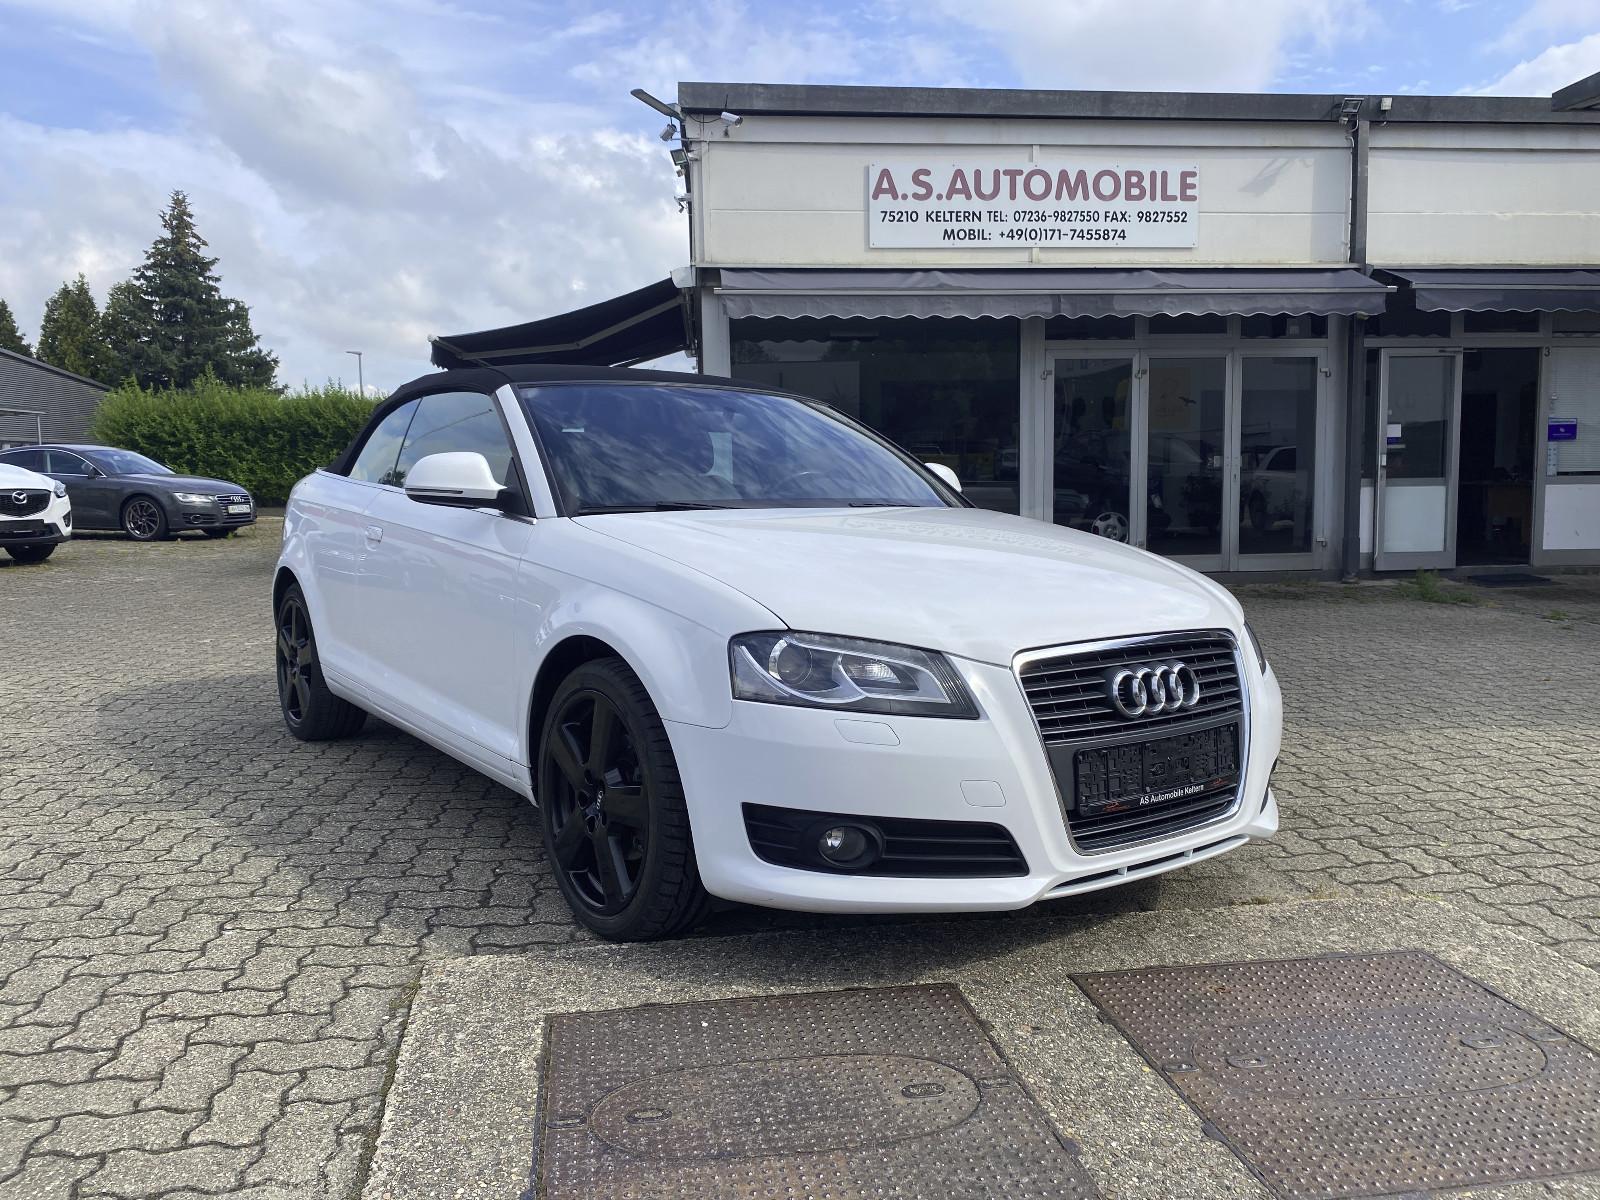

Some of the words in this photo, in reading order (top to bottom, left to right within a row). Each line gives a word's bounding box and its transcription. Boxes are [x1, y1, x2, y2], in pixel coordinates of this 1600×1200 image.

[872, 168, 1197, 202] A.S.AUTOMOBILE
[880, 210, 919, 223] 75210
[925, 211, 982, 223] KELTERN
[986, 211, 1008, 223] TEL:
[1013, 211, 1100, 223] 07236-9827550
[1104, 211, 1131, 223] FAX:
[1136, 211, 1188, 223] 9827552
[942, 228, 991, 241] MOBIL:
[999, 228, 1127, 242] +49(0)171-7455874
[1544, 347, 1551, 357] 3
[1139, 795, 1150, 805] AS
[1150, 789, 1184, 803] Automobile
[1184, 784, 1204, 795] Keltern
